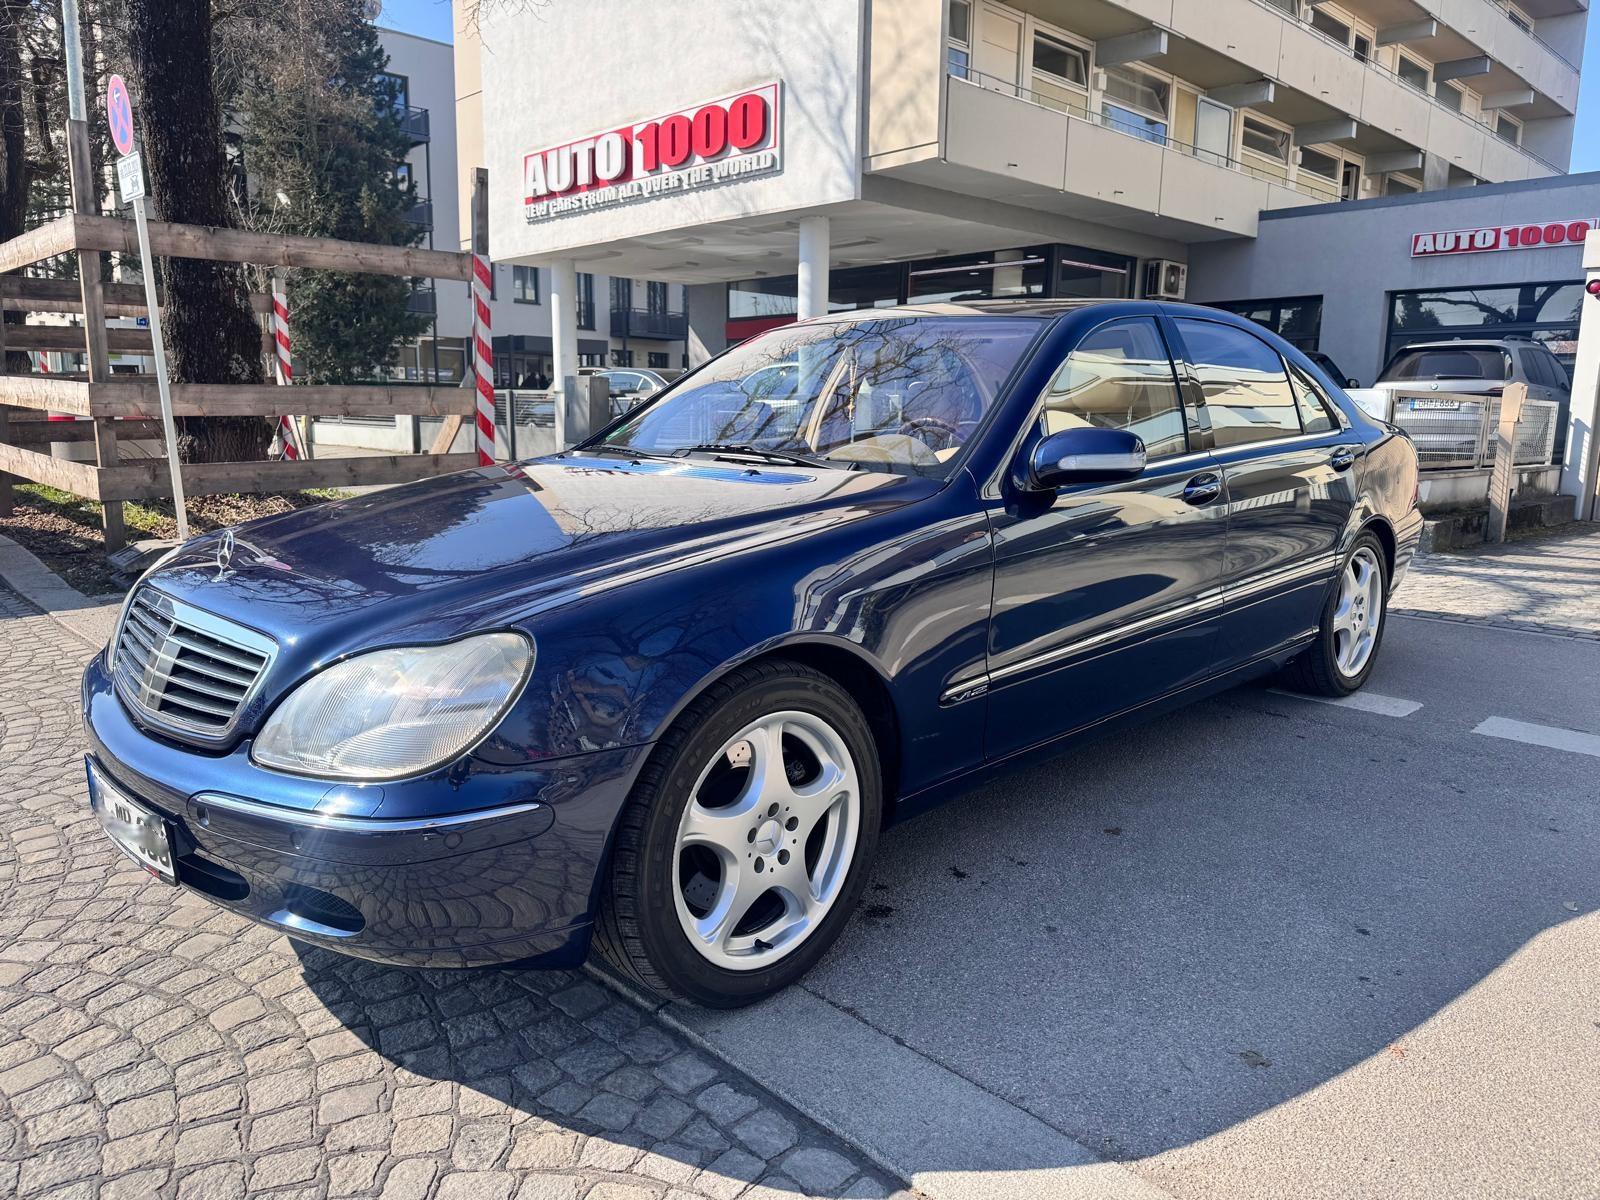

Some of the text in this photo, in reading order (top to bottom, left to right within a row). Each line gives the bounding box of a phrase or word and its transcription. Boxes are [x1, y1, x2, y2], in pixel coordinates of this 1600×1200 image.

[525, 93, 767, 198] AUTO 1000
[549, 196, 580, 213] CARS
[581, 186, 616, 207] FROM
[617, 181, 642, 200] ALL
[642, 175, 680, 192] OVER
[682, 167, 711, 186] THE
[711, 153, 774, 177] WORLD
[1415, 221, 1590, 253] AUTO 1000
